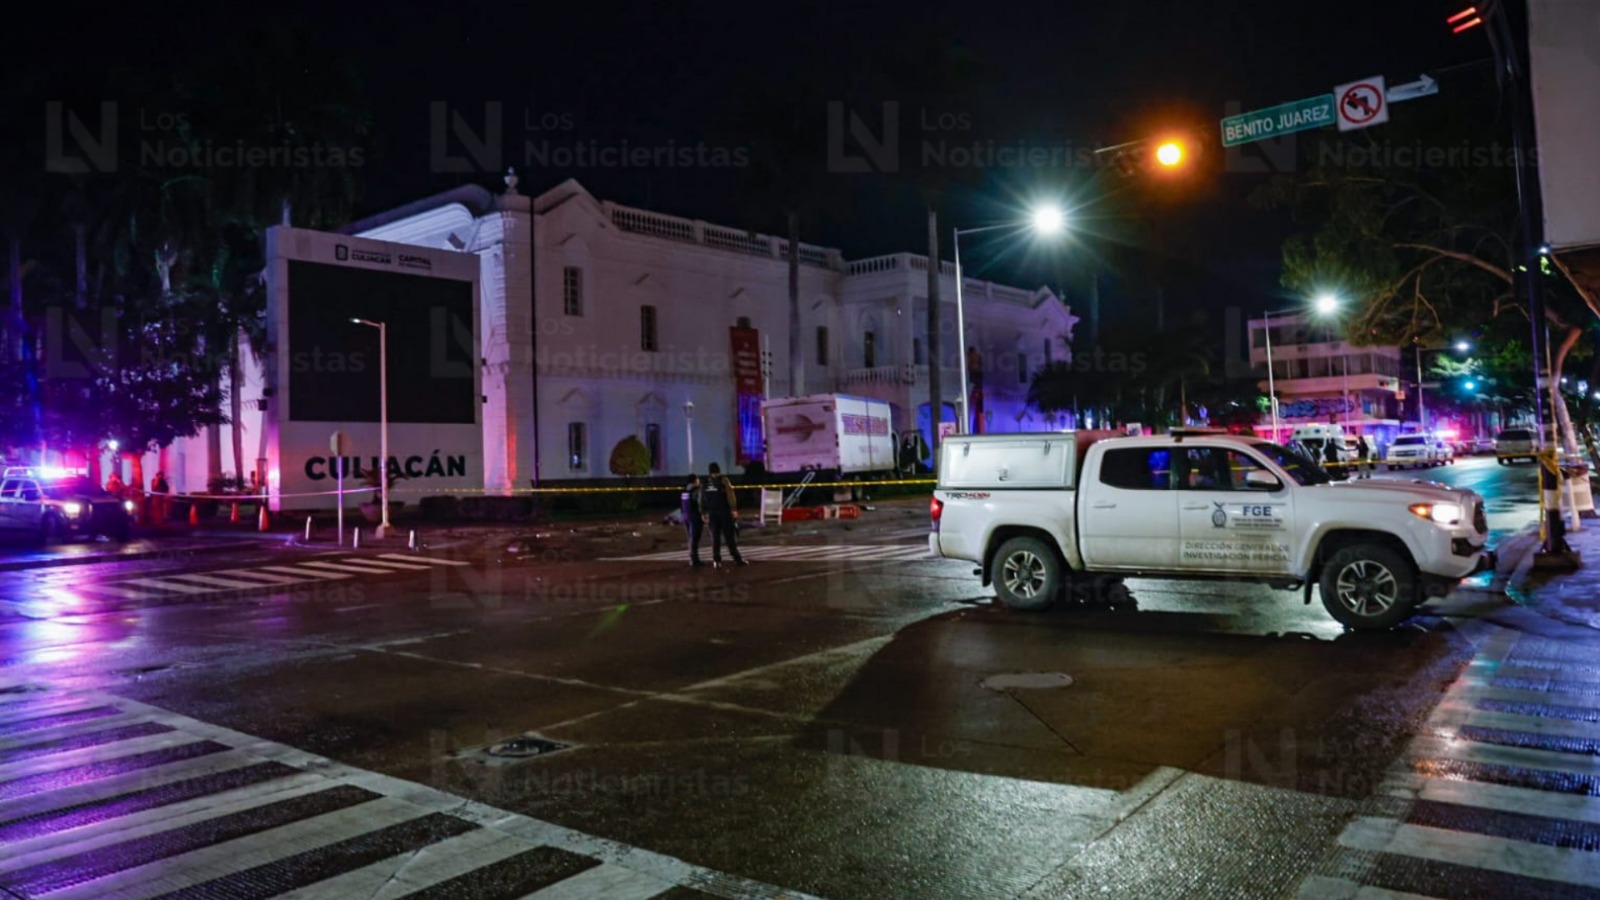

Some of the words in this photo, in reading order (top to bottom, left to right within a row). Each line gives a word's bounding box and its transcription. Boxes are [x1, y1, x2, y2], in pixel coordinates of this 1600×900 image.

[1226, 118, 1274, 141] BENITO
[1277, 104, 1330, 130] JUAREZ
[304, 449, 466, 481] CULIACÁN
[1243, 506, 1272, 517] FGE
